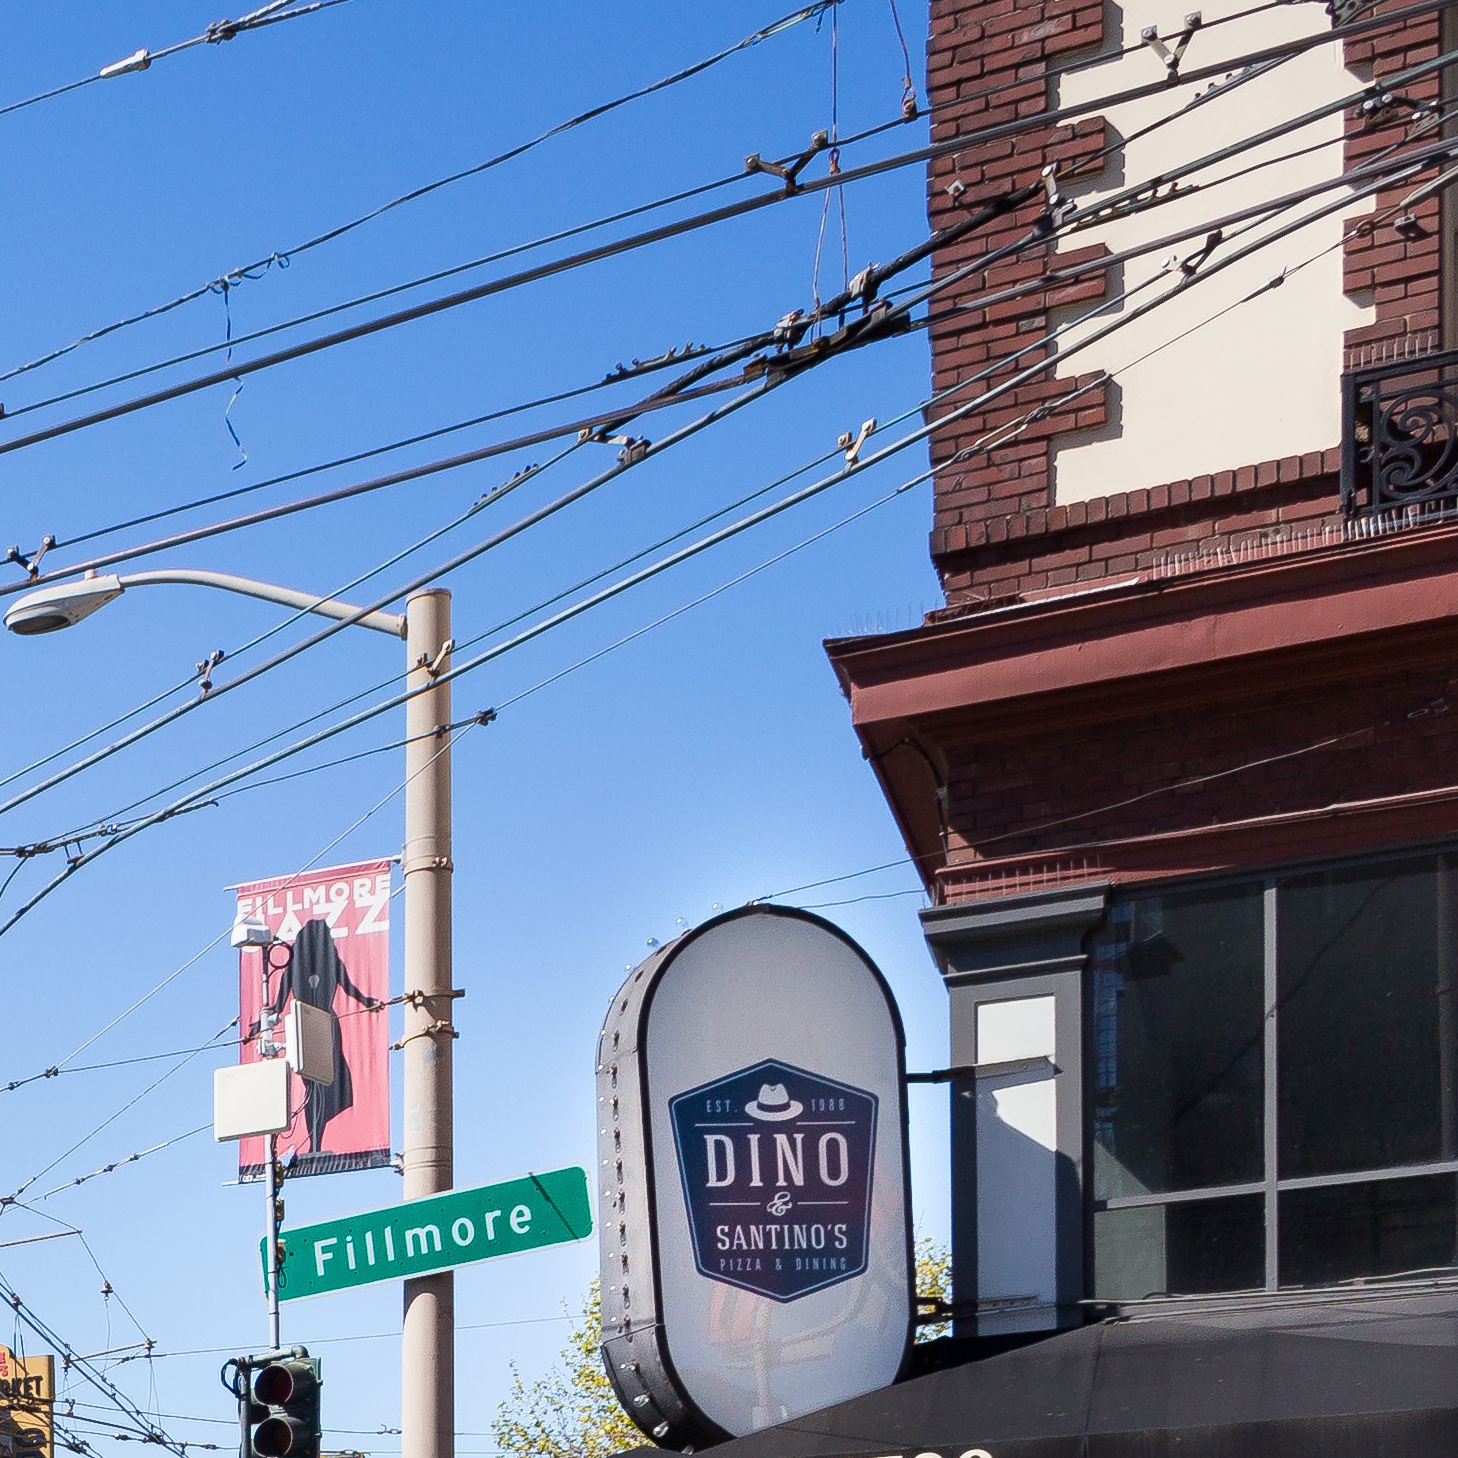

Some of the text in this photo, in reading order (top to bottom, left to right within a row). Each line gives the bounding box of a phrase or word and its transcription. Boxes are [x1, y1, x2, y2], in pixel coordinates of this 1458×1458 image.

[237, 874, 390, 918] FILLMORE
[703, 1132, 849, 1187] DINO
[766, 1191, 793, 1216] &
[314, 1204, 533, 1277] Fillmore
[716, 1223, 848, 1250] SANTINO'S
[720, 1258, 762, 1271] PIZZA
[795, 1256, 847, 1271] DINING
